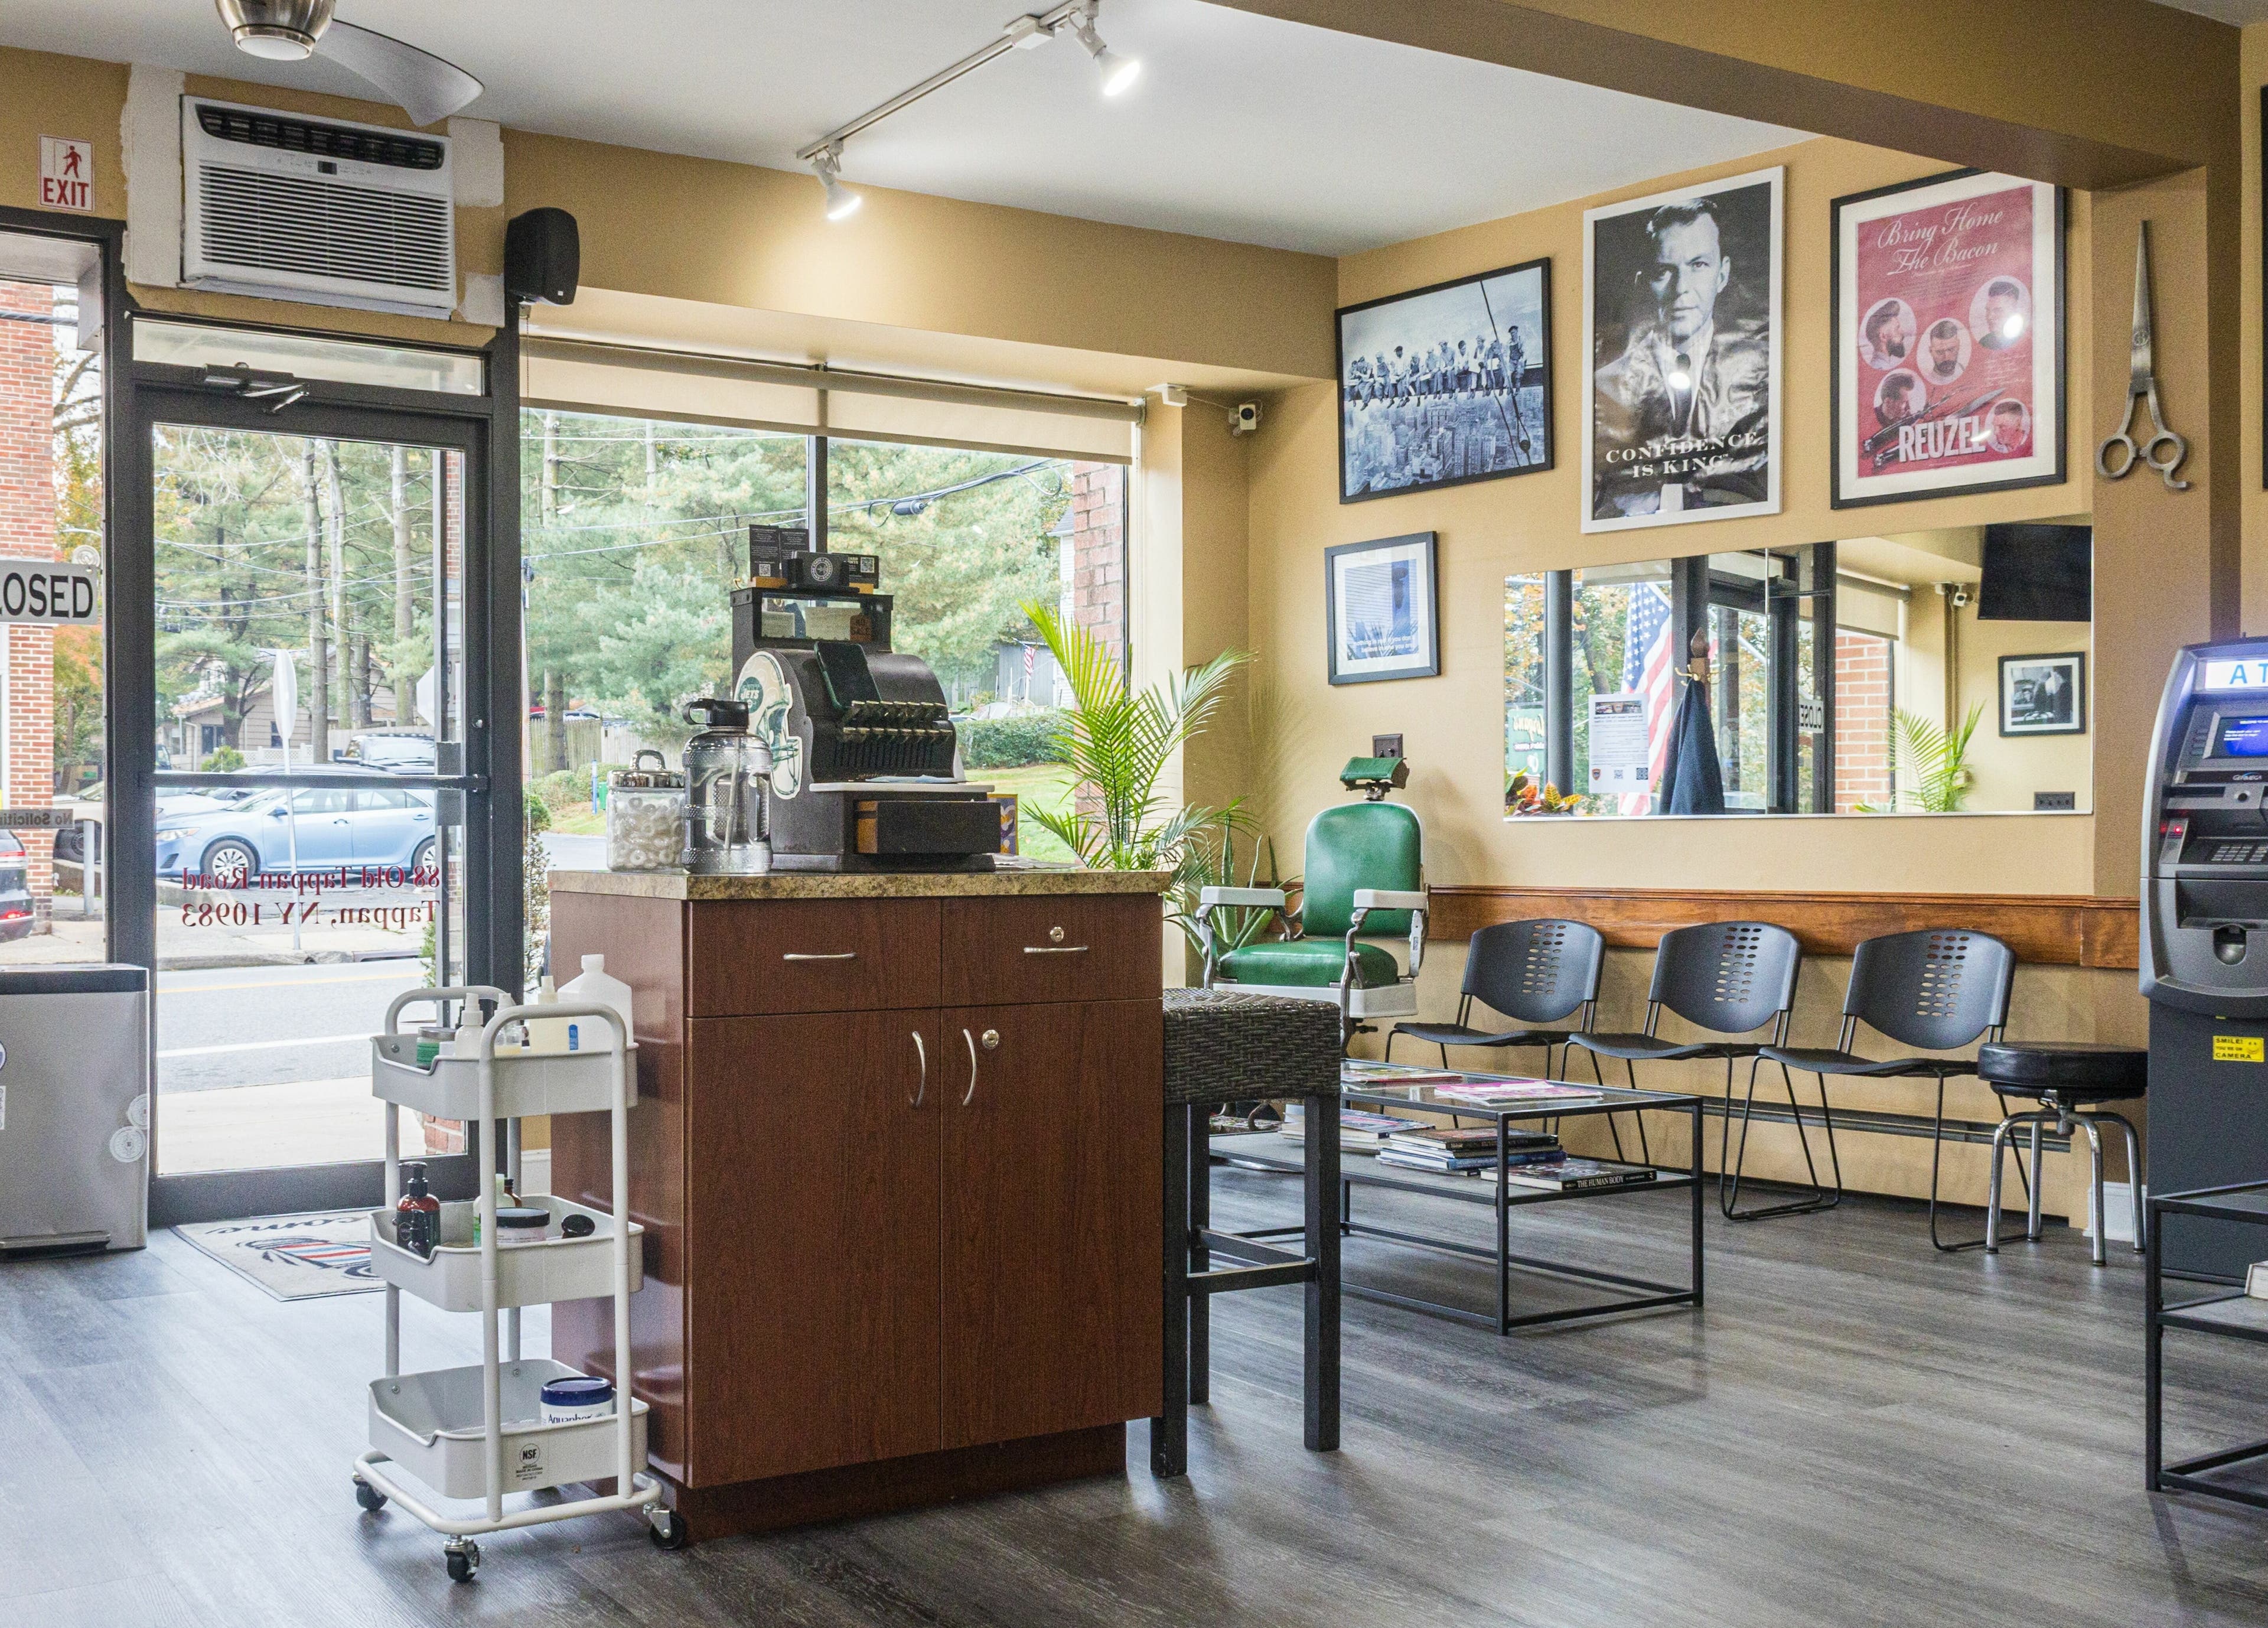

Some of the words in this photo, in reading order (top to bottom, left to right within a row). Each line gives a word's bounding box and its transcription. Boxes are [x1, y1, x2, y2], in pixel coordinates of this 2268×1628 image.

[43, 177, 89, 207] EXIT
[1878, 215, 1938, 249] Bring
[1941, 202, 2003, 235] Home
[1886, 239, 1933, 275] The
[1934, 236, 1998, 265] Bacon
[1605, 432, 1757, 463] CONFIDENCE
[1899, 415, 1986, 462] REUZEL
[1632, 464, 1654, 477] IS
[0, 572, 93, 618] OSED
[2228, 663, 2268, 685] AT
[740, 689, 760, 699] JETS
[1576, 1179, 1588, 1189] THE
[1588, 1177, 1609, 1187] HUMAN
[1609, 1175, 1624, 1185] BODY
[522, 1448, 537, 1460] NSF
